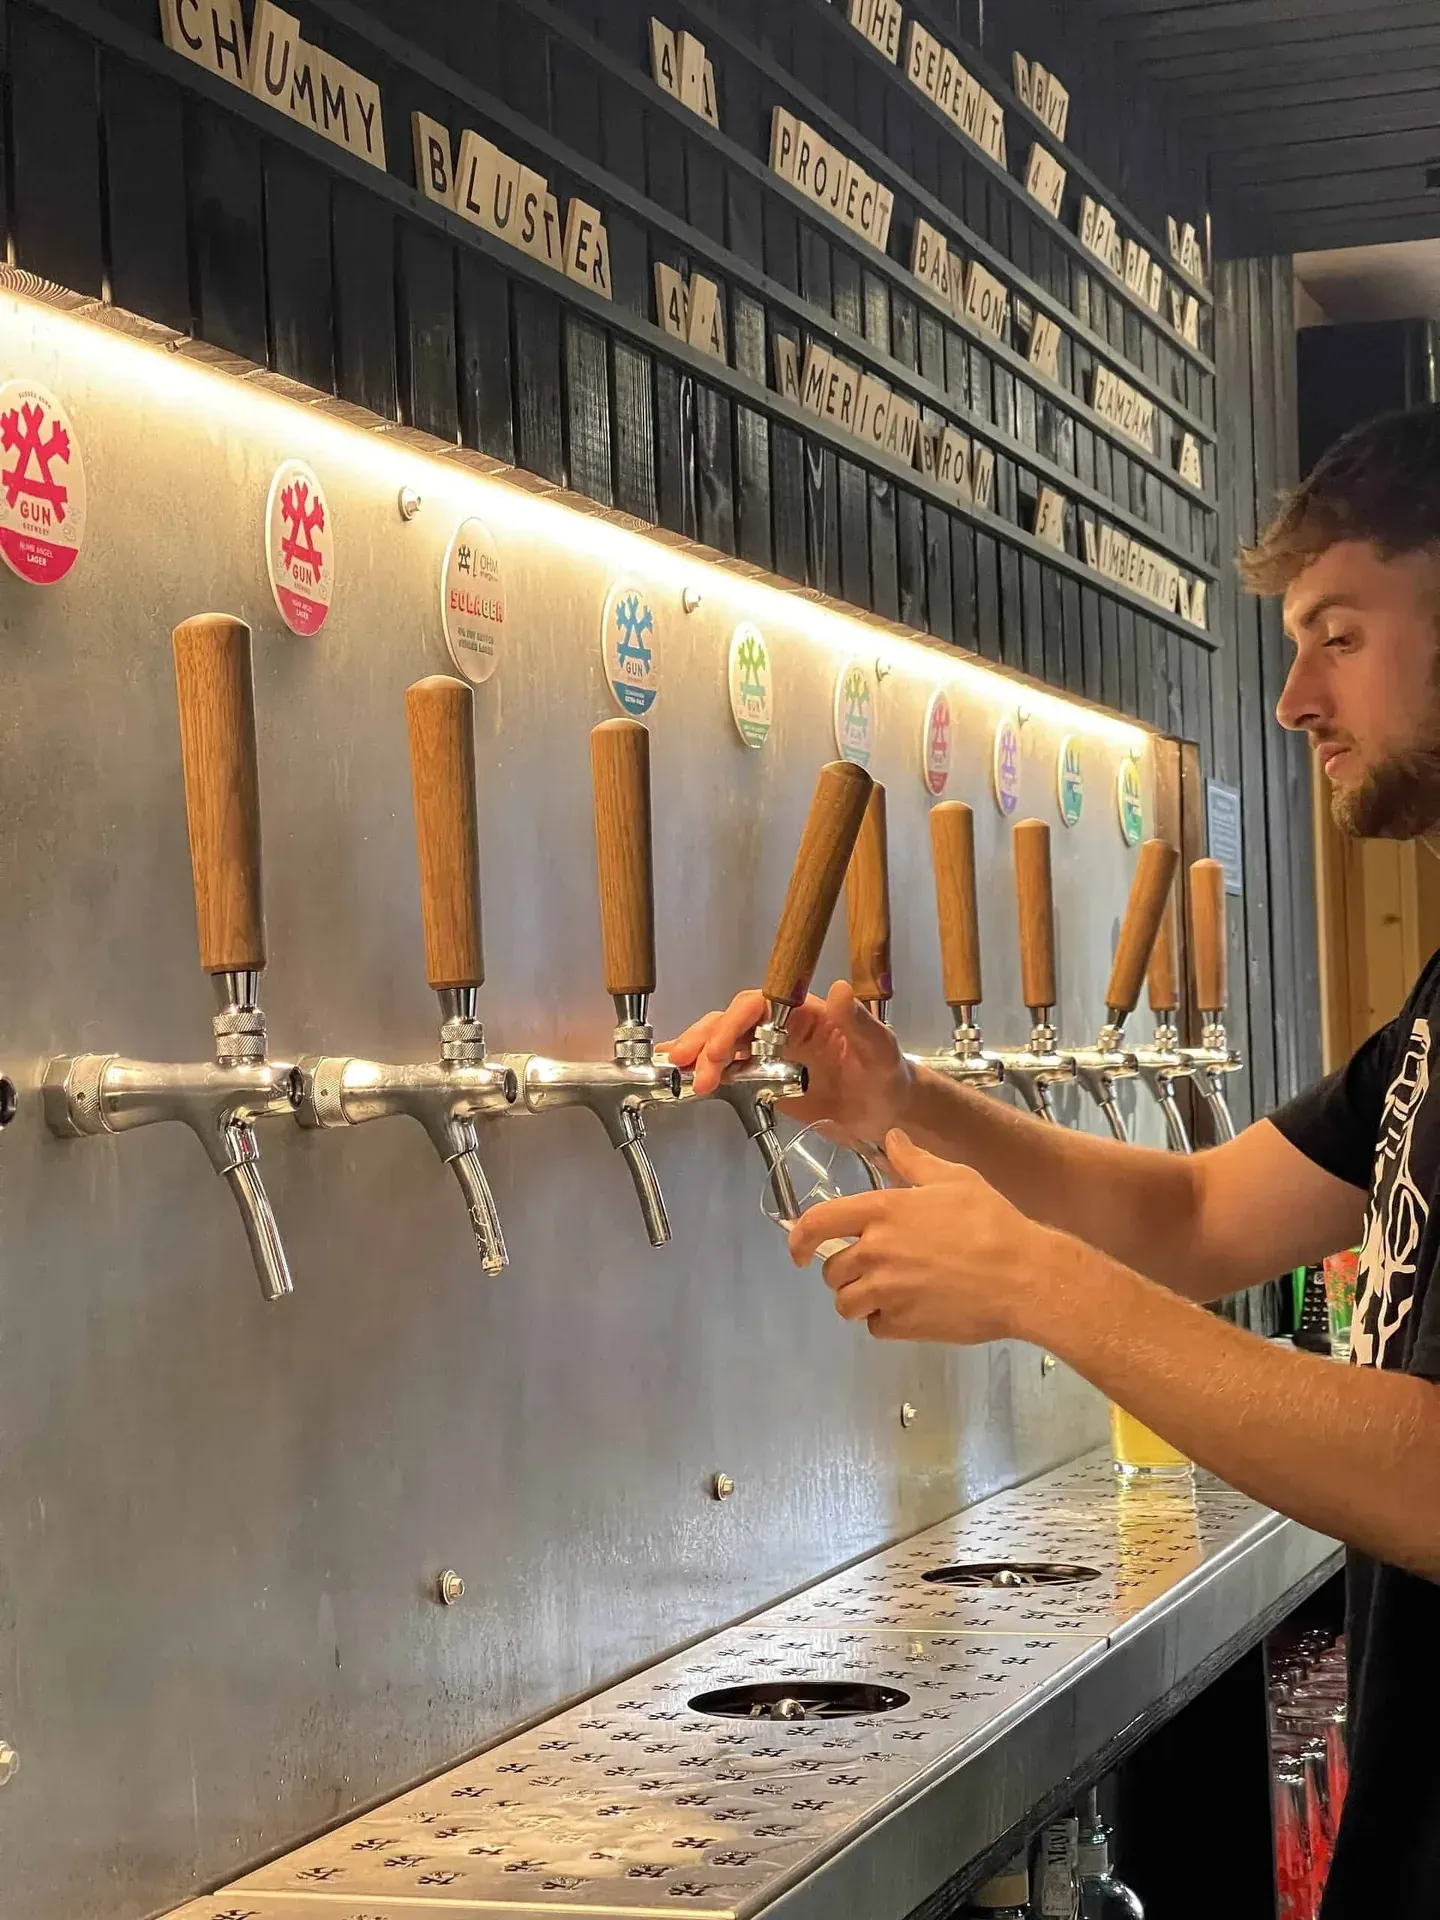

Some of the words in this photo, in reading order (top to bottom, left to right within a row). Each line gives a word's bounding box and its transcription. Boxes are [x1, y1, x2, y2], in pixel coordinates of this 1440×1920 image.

[913, 41, 1003, 162] SERENIT
[176, 0, 374, 153] CHUMMY
[428, 136, 606, 288] BLUSTER
[1031, 161, 1061, 210] 4.4
[778, 126, 890, 242] PROJECT
[917, 235, 1004, 335] BABYLON
[785, 353, 914, 457] AMERICAN
[923, 436, 991, 504] BRON
[1096, 379, 1151, 443] ZAMZAM
[20, 499, 51, 527] GUN
[292, 564, 312, 587] GUN
[480, 554, 499, 574] OHM
[625, 661, 643, 678] GUN
